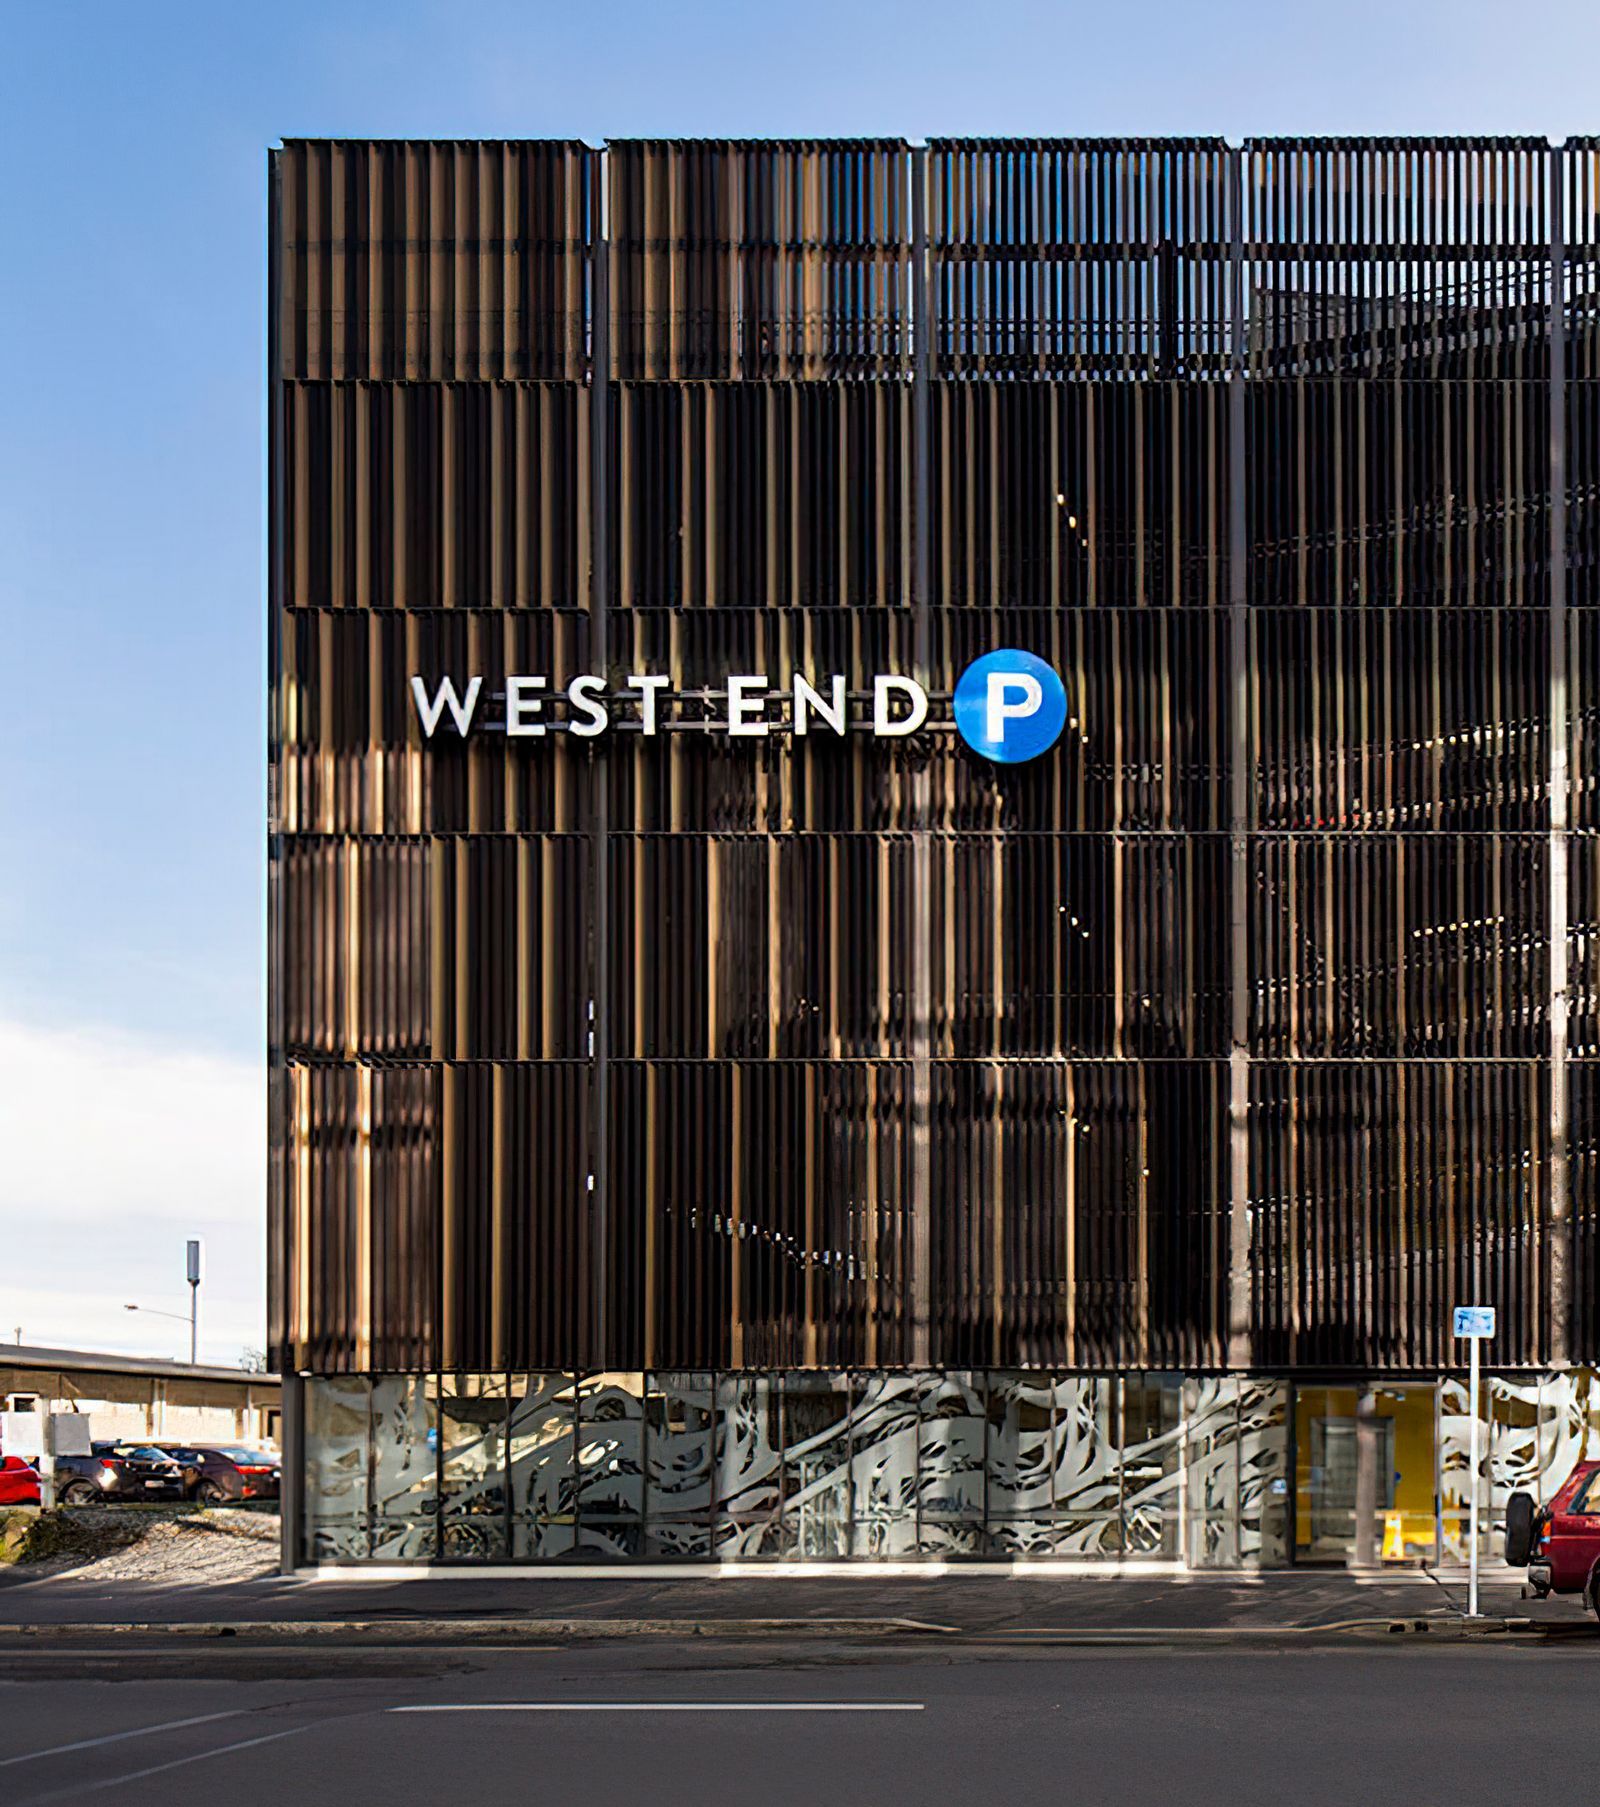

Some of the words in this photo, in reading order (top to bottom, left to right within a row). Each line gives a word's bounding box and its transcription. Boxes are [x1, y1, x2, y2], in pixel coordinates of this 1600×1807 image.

[411, 674, 669, 738] WEST
[727, 674, 929, 737] END
[986, 672, 1043, 743] P
